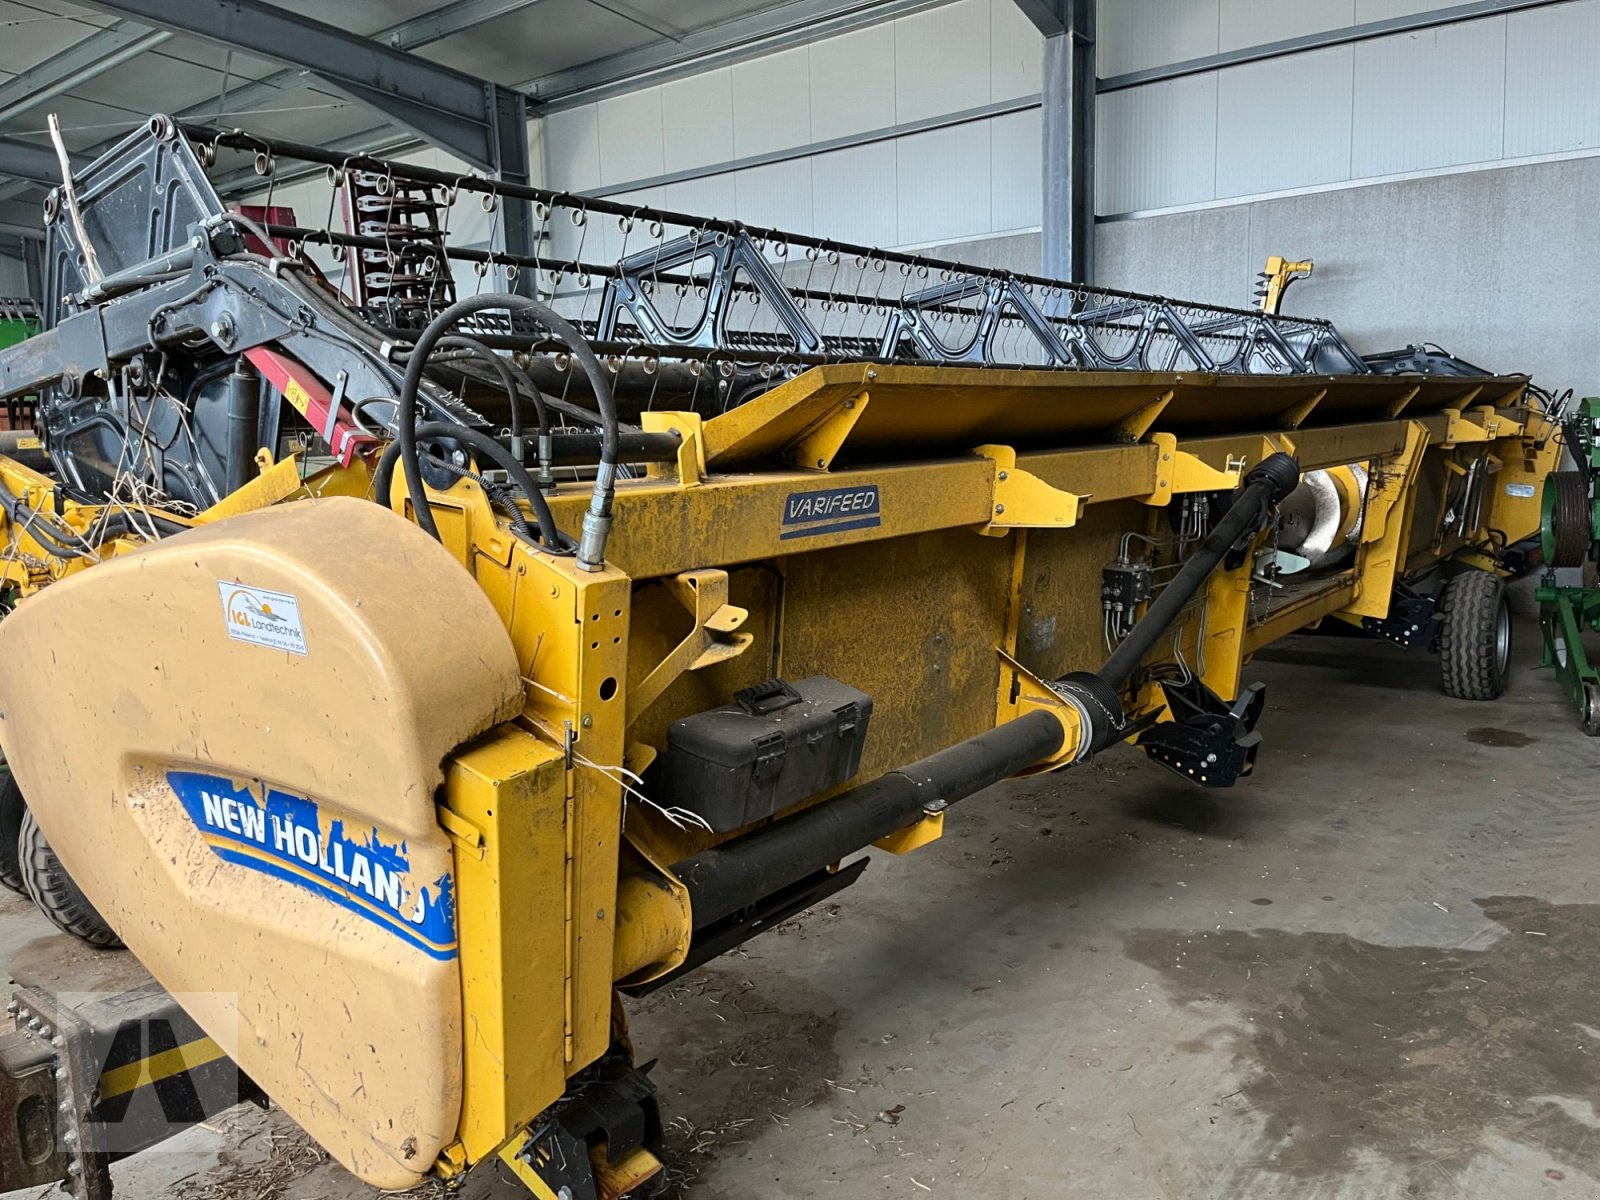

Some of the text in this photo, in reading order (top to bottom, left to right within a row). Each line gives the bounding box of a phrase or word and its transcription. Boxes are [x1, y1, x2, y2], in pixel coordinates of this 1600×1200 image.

[790, 492, 875, 518] VARIFEED
[231, 609, 251, 628] IGL
[252, 617, 303, 640] Landtechnik
[201, 791, 266, 844] NEW
